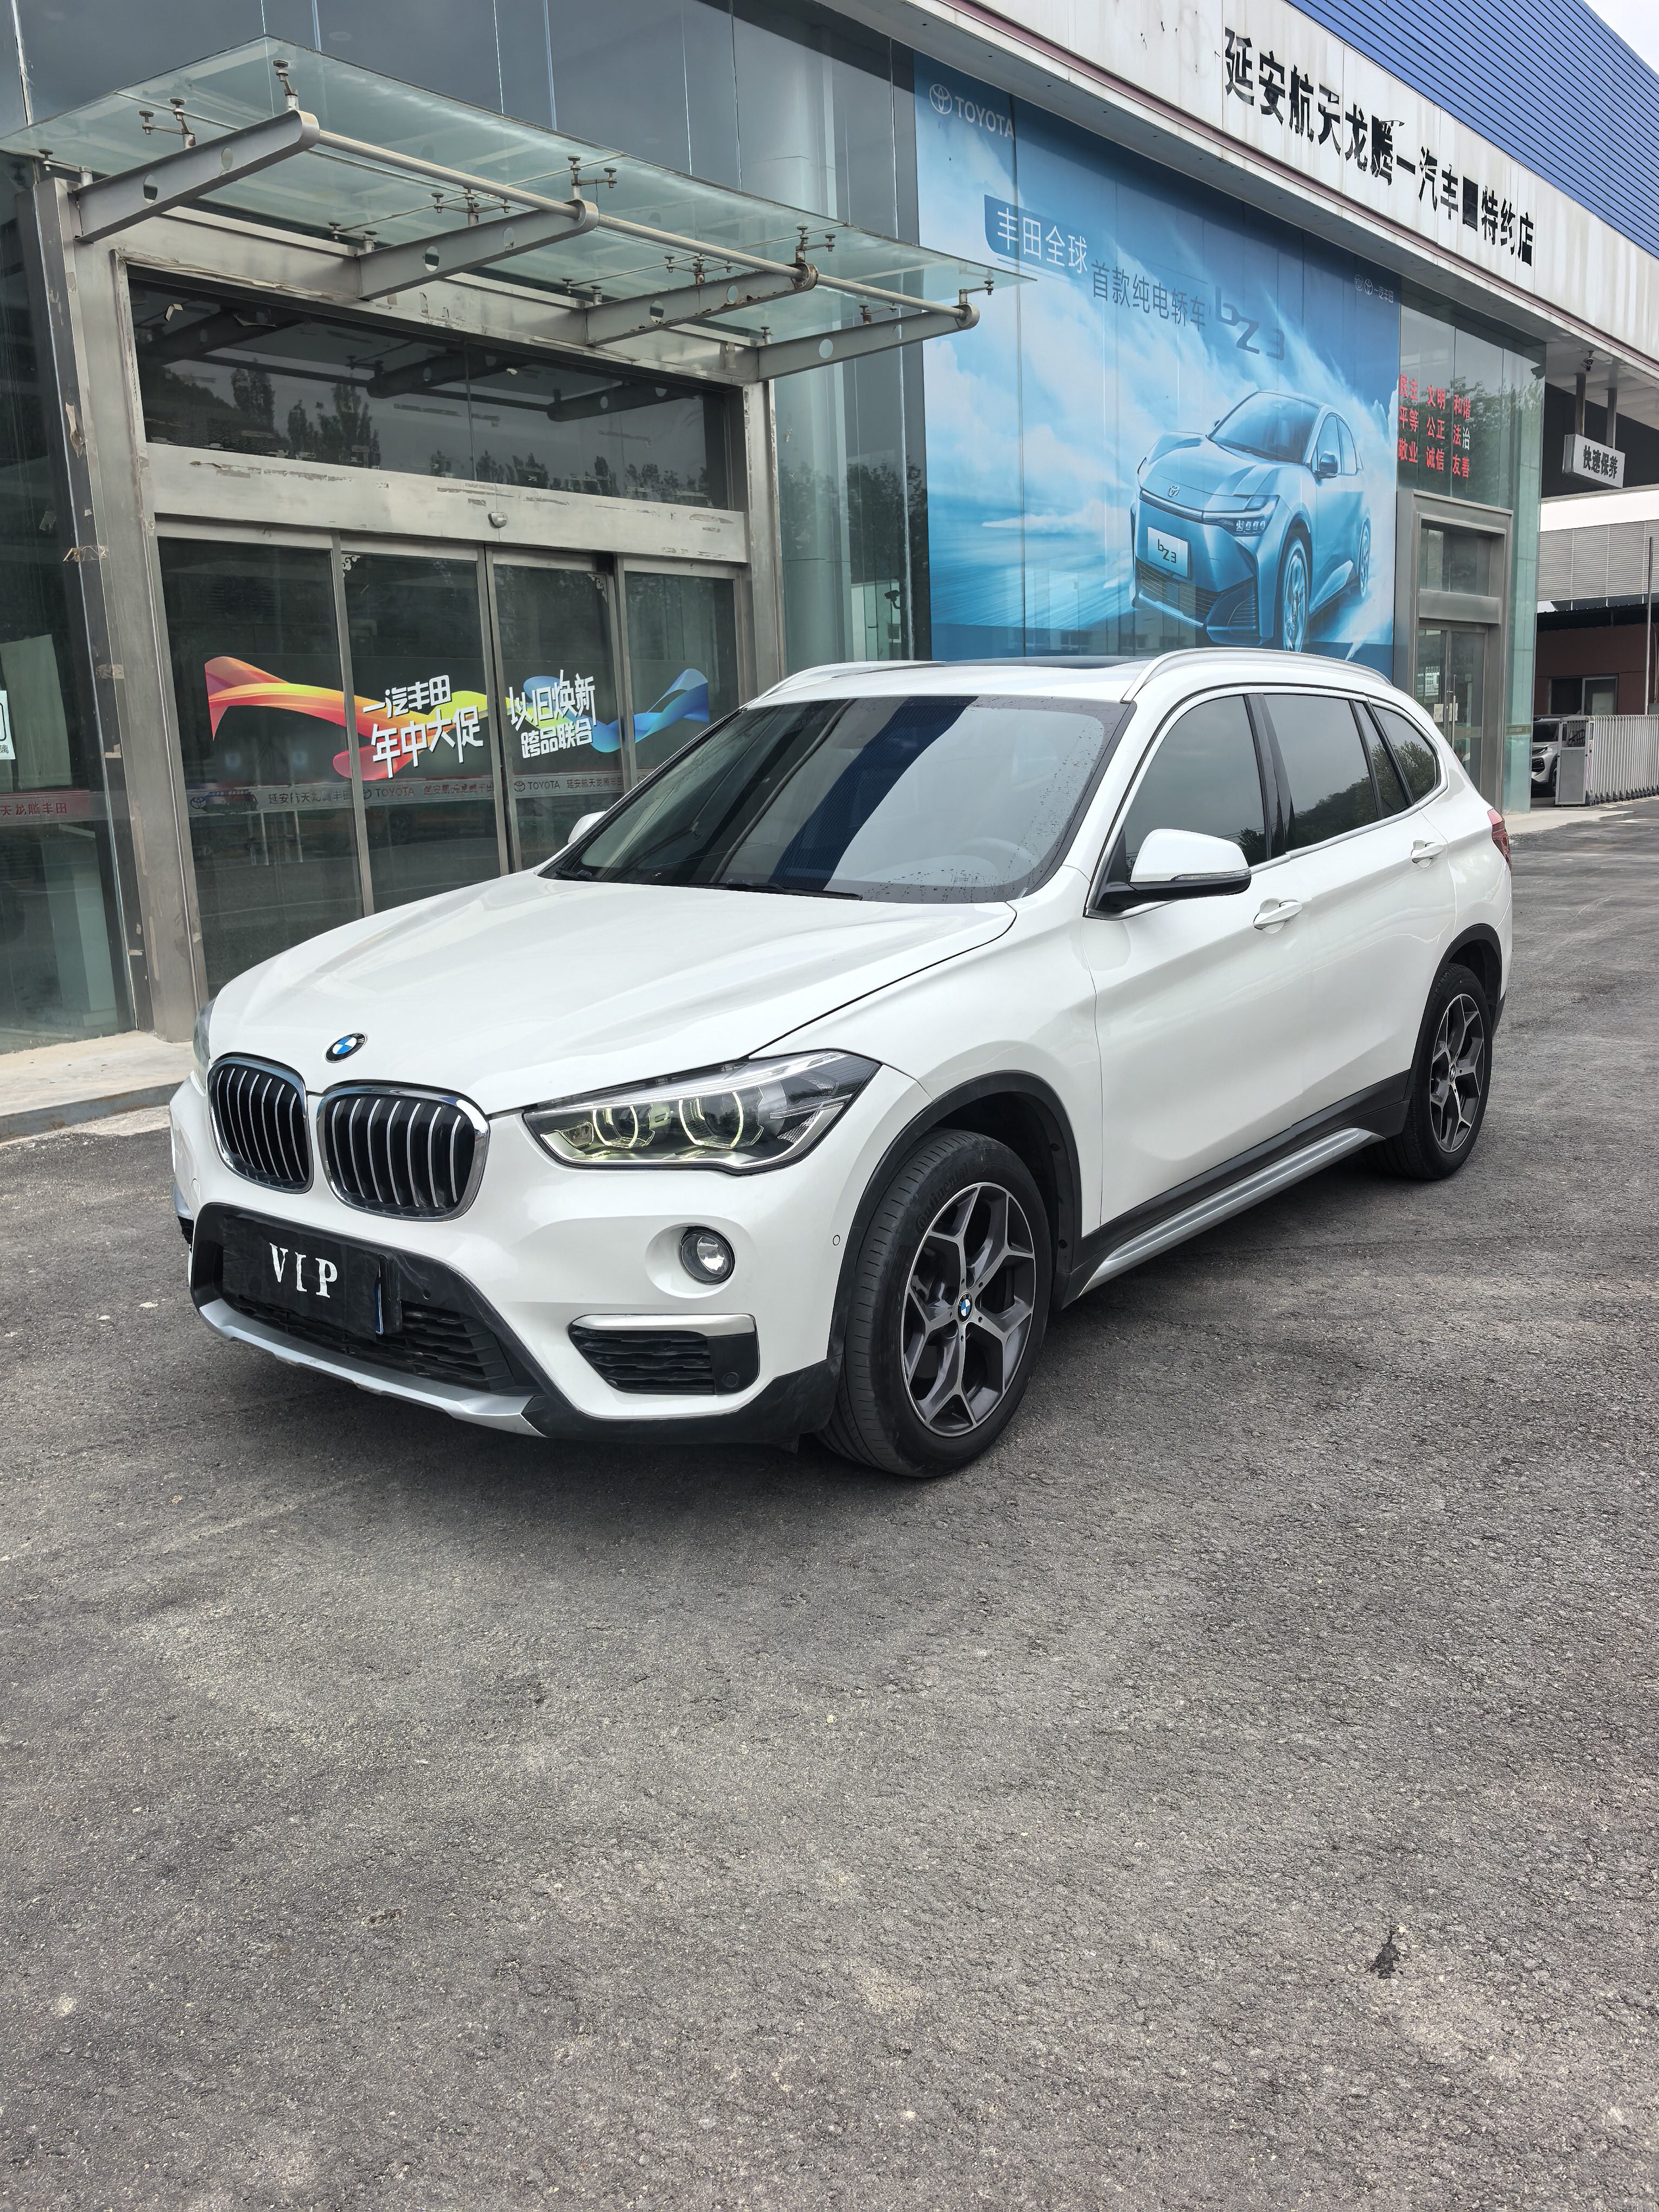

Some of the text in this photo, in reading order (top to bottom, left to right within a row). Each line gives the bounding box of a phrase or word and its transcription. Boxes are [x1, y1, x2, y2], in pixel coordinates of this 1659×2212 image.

[955, 96, 1014, 139] TOYOTA
[997, 207, 1205, 332] 丰田全球 首款纯电轿车
[1399, 374, 1471, 419] 民主 文明 和谐
[1399, 406, 1470, 450] 平等 公正 法治
[1398, 437, 1469, 478] 敬业 诚信 友善
[1583, 445, 1618, 480] 快速保养
[362, 675, 451, 718] 一汽丰田
[509, 669, 596, 731] 以旧焕新
[371, 705, 483, 779] 年中大促
[521, 717, 592, 759] 跨品联合
[376, 786, 415, 798] TOYOTA
[528, 780, 560, 790] TOYOTA
[269, 1242, 338, 1298] VIP
